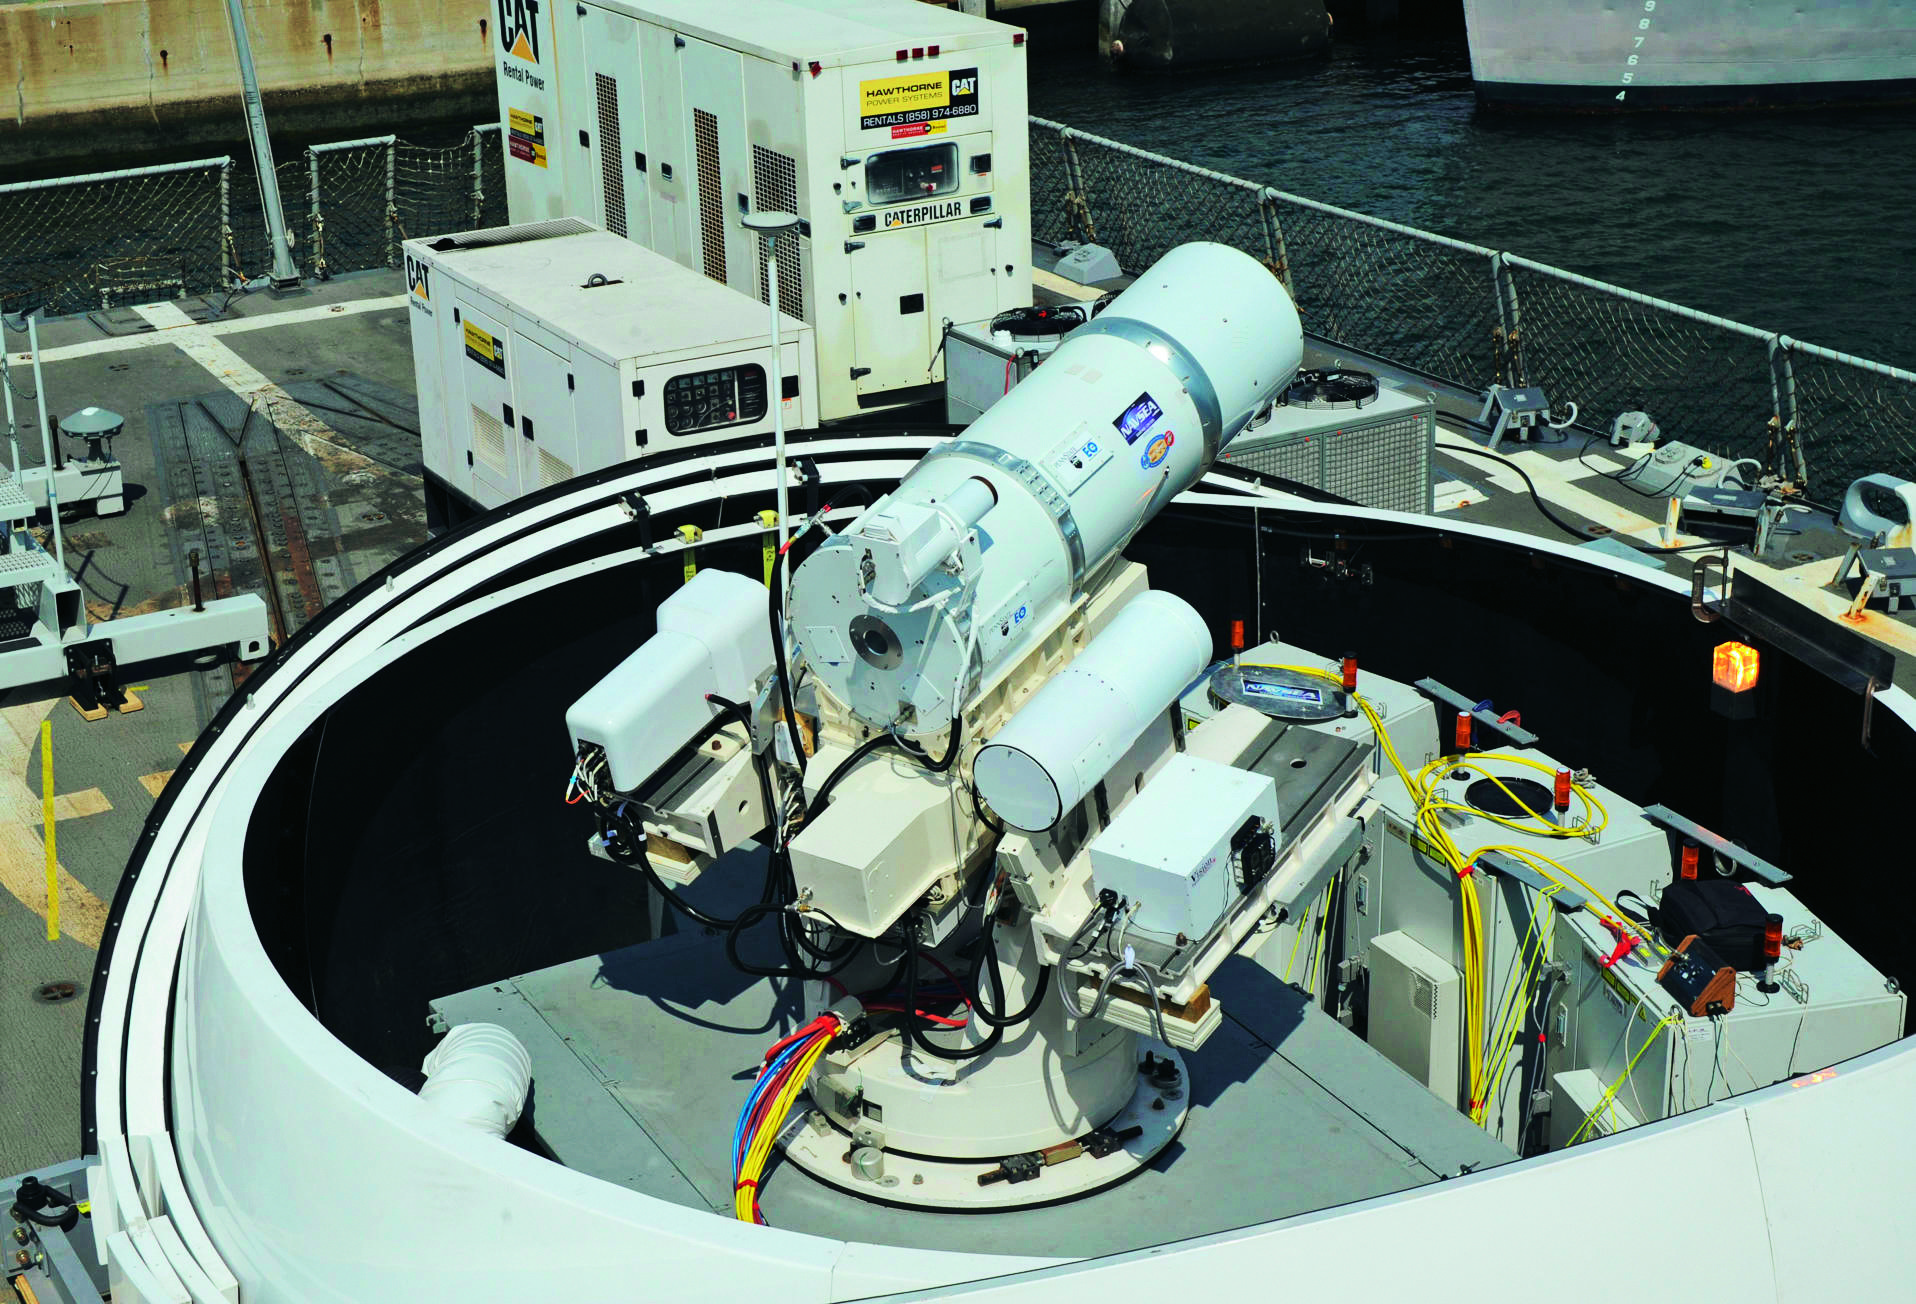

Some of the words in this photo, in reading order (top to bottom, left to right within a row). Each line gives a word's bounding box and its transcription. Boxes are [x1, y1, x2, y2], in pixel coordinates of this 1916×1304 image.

[1644, 0, 1656, 12] 9
[497, 0, 540, 65] CAT
[1638, 18, 1650, 30] 8
[1634, 36, 1645, 48] 7
[1627, 54, 1639, 66] 6
[503, 61, 524, 83] Rental
[525, 69, 545, 92] Power
[1622, 72, 1634, 84] 5
[866, 81, 943, 98] HAWTHORNE
[951, 77, 976, 96] CAT
[866, 97, 900, 107] POWER
[902, 91, 943, 103] SYSTEMS
[1615, 90, 1626, 101] 4
[863, 113, 904, 127] RENTALS
[906, 110, 930, 122] (858)
[932, 104, 977, 118] 974-6880
[885, 202, 961, 227] CATERPILLAR
[406, 254, 430, 301] CAT
[1120, 401, 1158, 438] NAVSEA
